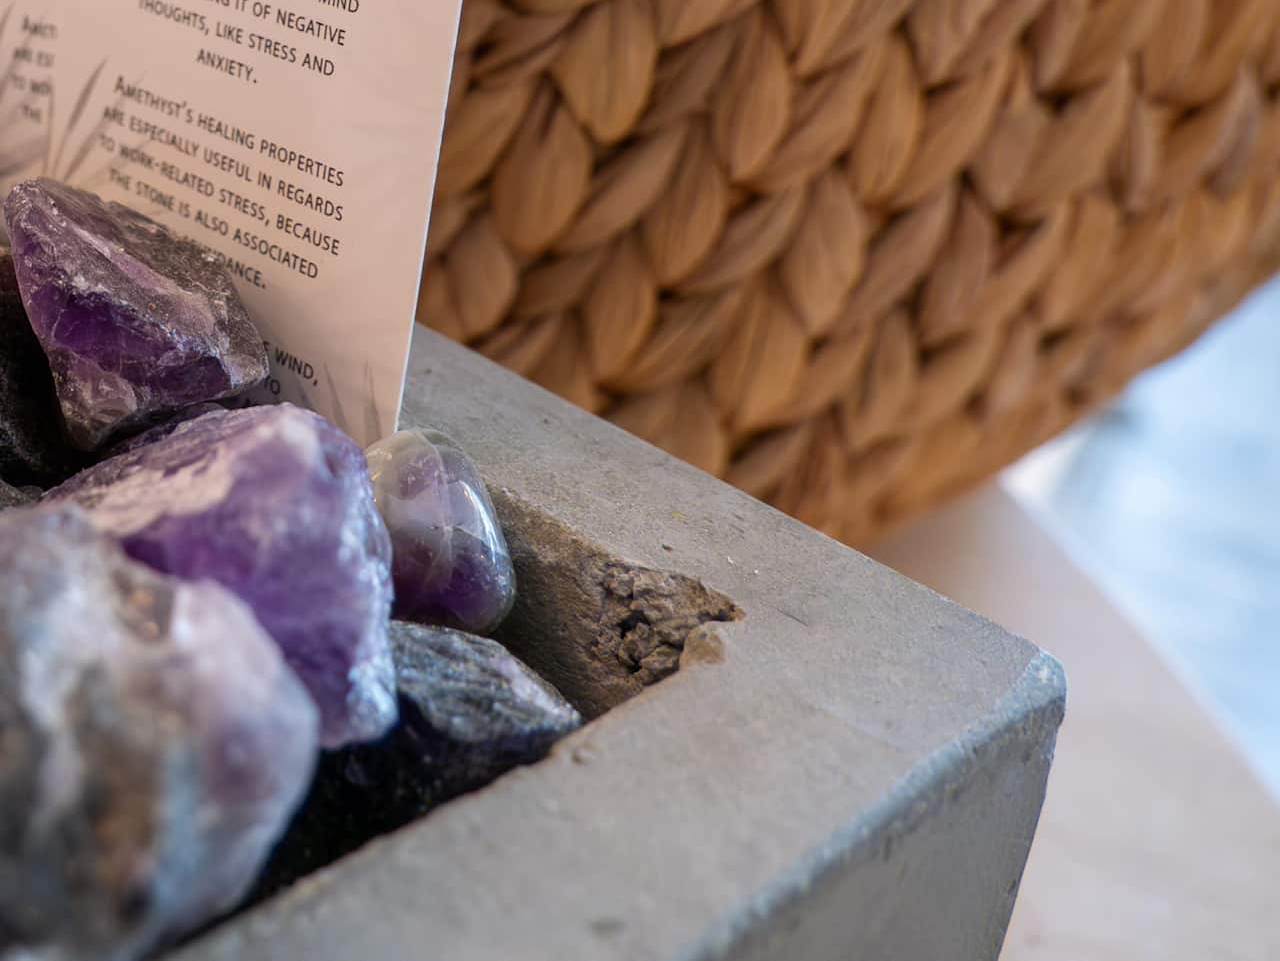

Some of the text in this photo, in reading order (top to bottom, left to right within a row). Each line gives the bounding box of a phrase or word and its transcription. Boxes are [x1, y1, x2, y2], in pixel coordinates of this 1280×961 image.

[196, 49, 257, 84] ANXIETY.
[215, 22, 243, 45] LIKE
[248, 33, 296, 63] STRESS
[301, 53, 334, 76] AND
[252, 1, 271, 19] OF
[276, 8, 346, 46] NEGATIVE
[115, 75, 344, 187] AMETHYST'S HEALING PROPERTIES
[129, 116, 199, 158] ESPECIALLY
[204, 148, 252, 182] USEFUL
[257, 170, 272, 191] IN
[277, 180, 343, 222] REGARDS
[98, 134, 340, 256] TO WORK-RELATED STRESS, BECAUSE
[109, 168, 318, 279] THE STONE IS ALSO ASSOCIATED
